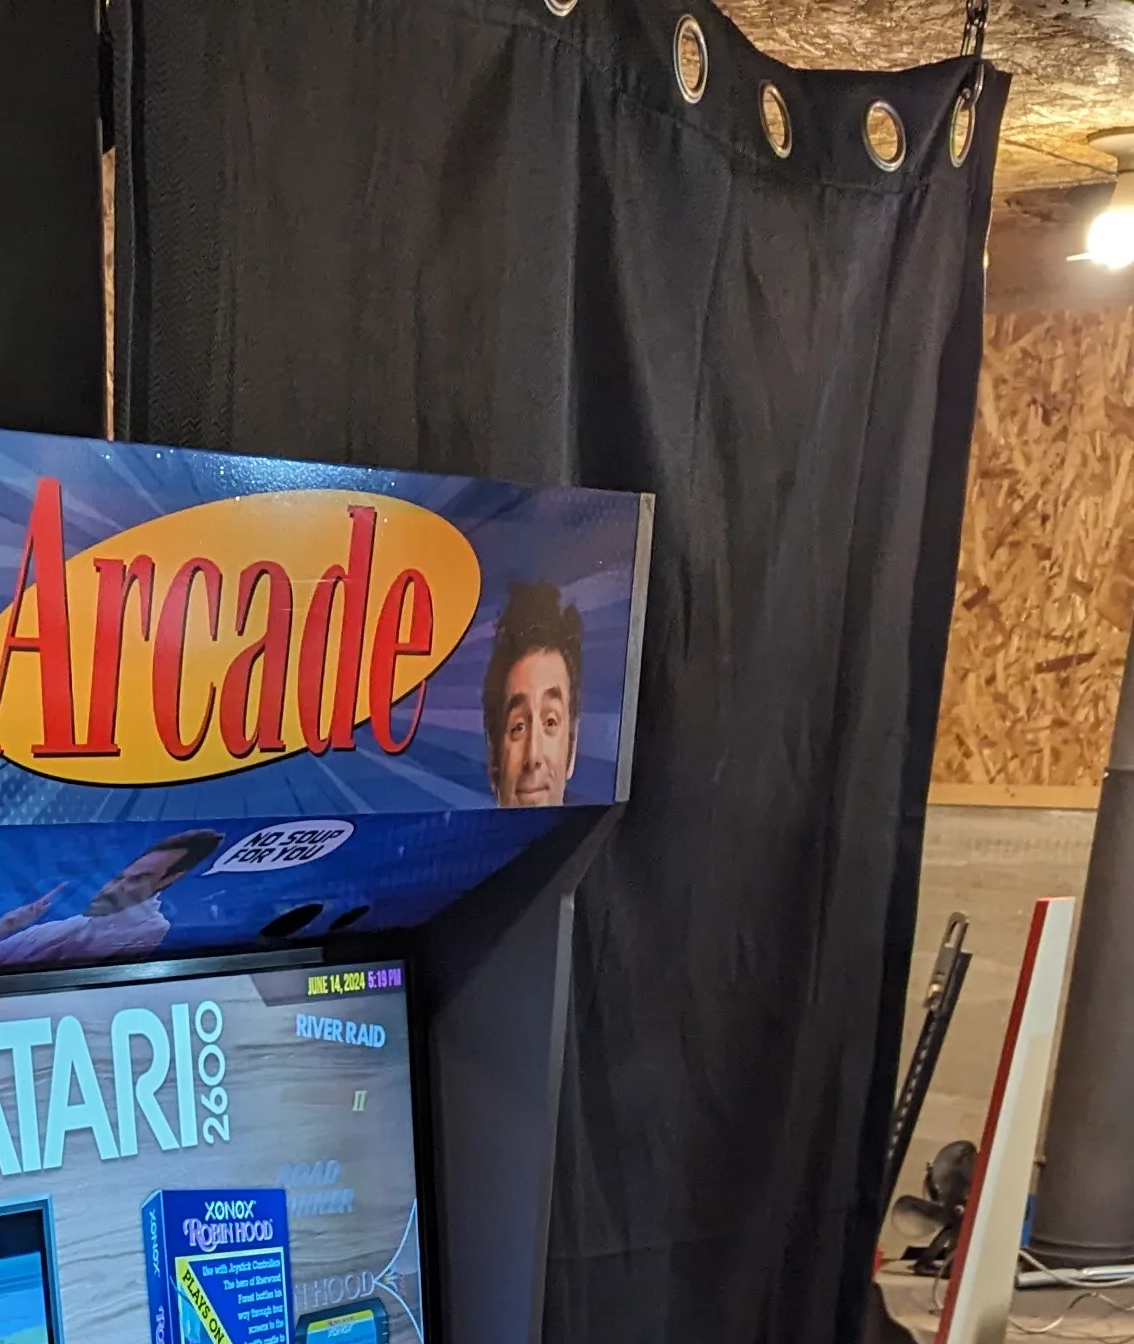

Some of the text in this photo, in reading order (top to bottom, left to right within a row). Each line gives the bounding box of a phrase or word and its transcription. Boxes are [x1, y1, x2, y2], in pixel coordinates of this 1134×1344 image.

[244, 829, 346, 848] NO SOUP
[223, 845, 325, 865] FOR YOU
[307, 968, 402, 996] JUNE 14, 2024 5:19 PM
[296, 1013, 386, 1048] RIVER RAID
[194, 1000, 231, 1145] 2600
[205, 1200, 257, 1221] XONOX
[183, 1218, 273, 1253] ROBIN HOOD
[182, 1269, 211, 1318] PLAYS
[209, 1318, 225, 1344] ON
